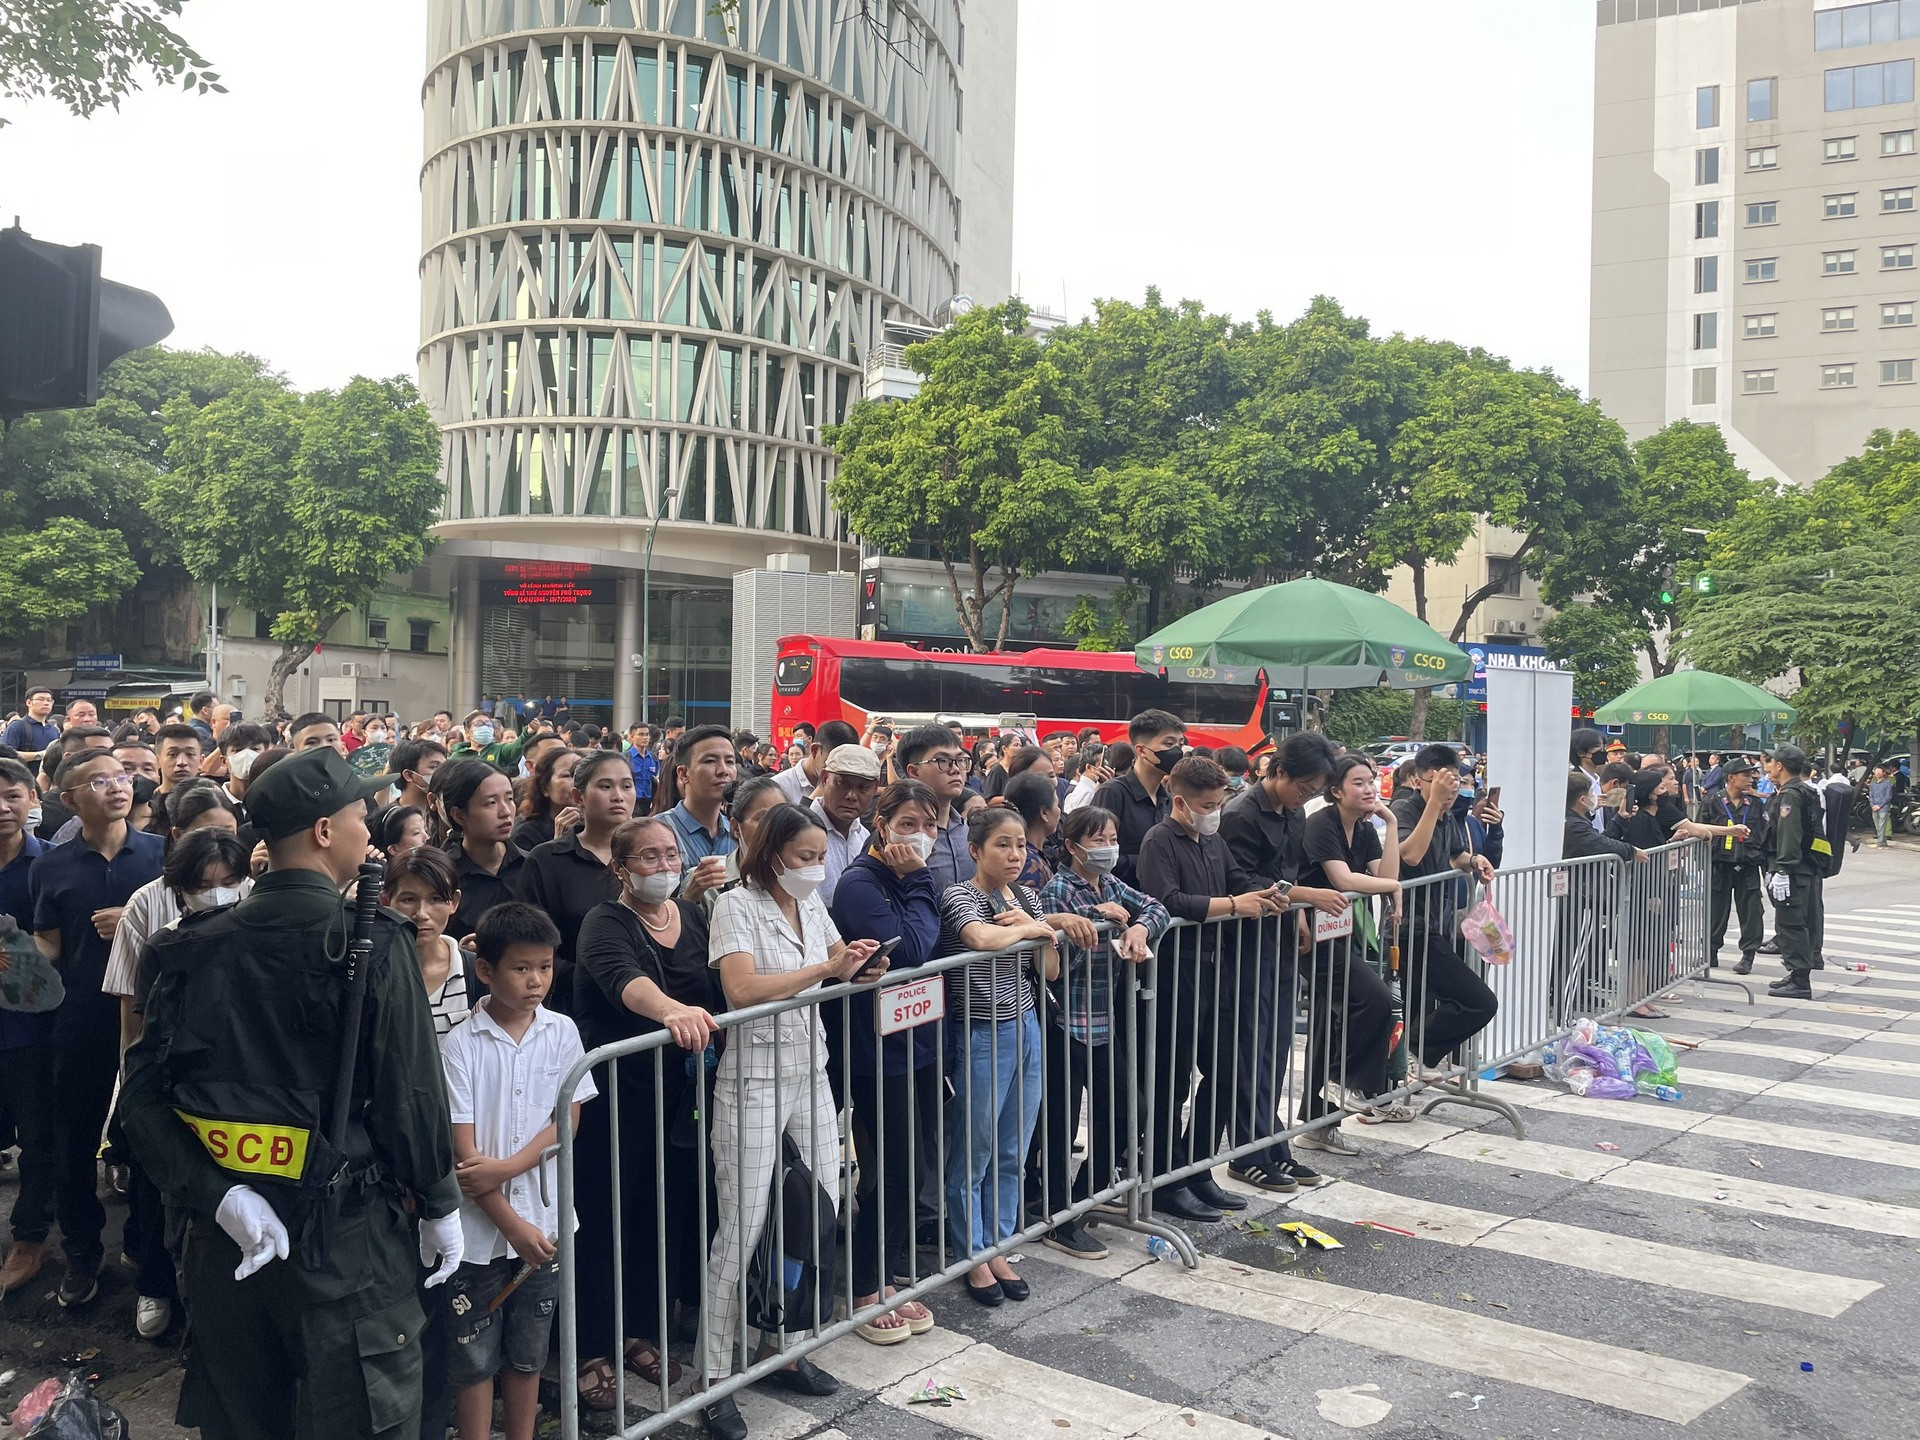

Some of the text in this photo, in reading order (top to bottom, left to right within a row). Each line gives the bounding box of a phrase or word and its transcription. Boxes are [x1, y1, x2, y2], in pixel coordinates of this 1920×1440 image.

[1169, 646, 1193, 659] CSCĐ
[1413, 653, 1446, 670] CSCĐ
[1488, 653, 1516, 667] NHA
[1647, 712, 1669, 721] CSCĐ
[1318, 920, 1338, 933] DỪNG
[897, 986, 926, 1000] POLICE
[894, 999, 931, 1022] STOP
